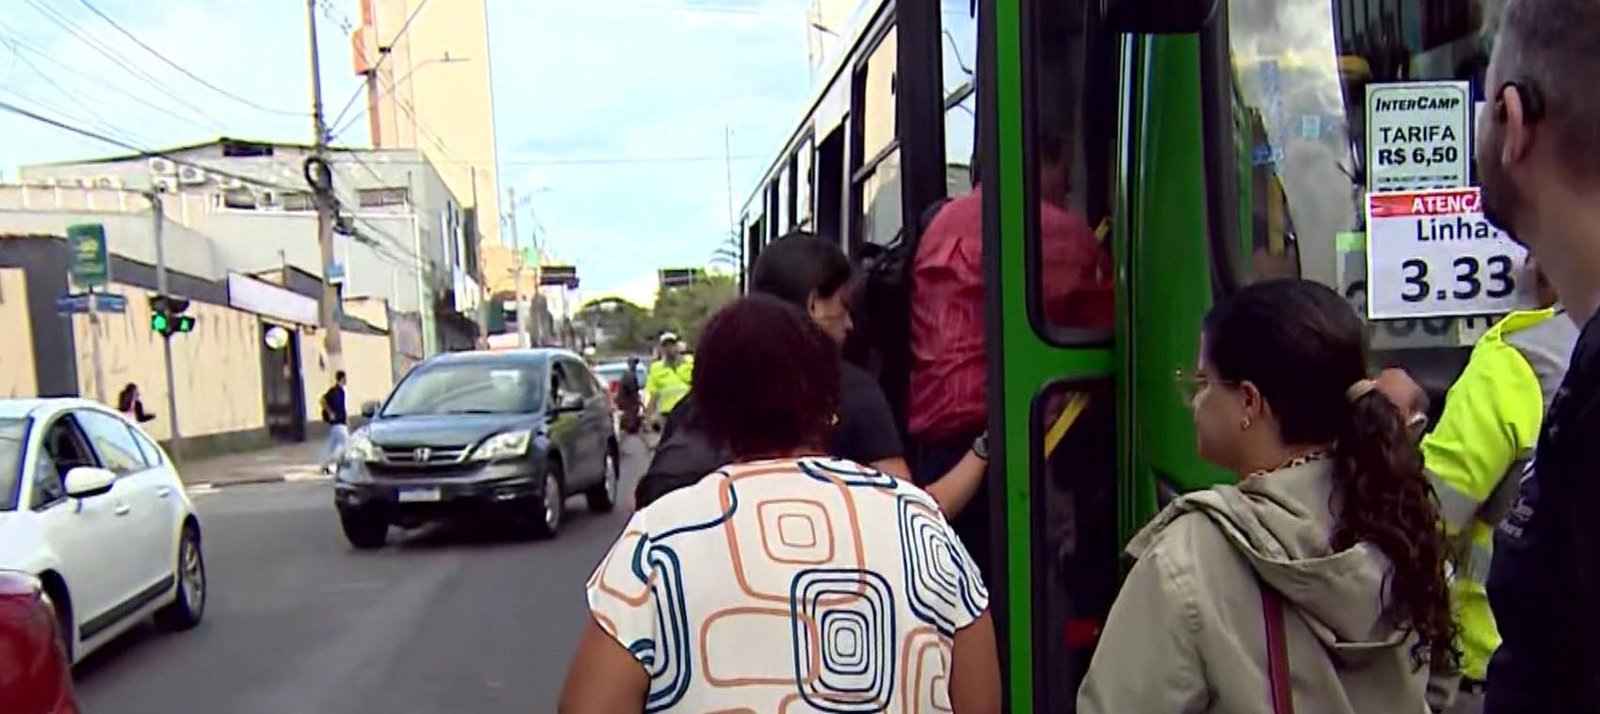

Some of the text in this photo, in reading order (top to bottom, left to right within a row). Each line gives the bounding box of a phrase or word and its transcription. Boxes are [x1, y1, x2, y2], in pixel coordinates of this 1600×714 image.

[1379, 124, 1455, 144] TARIFA
[1378, 146, 1458, 167] R$ 6,50
[1401, 255, 1515, 303] 3.33
